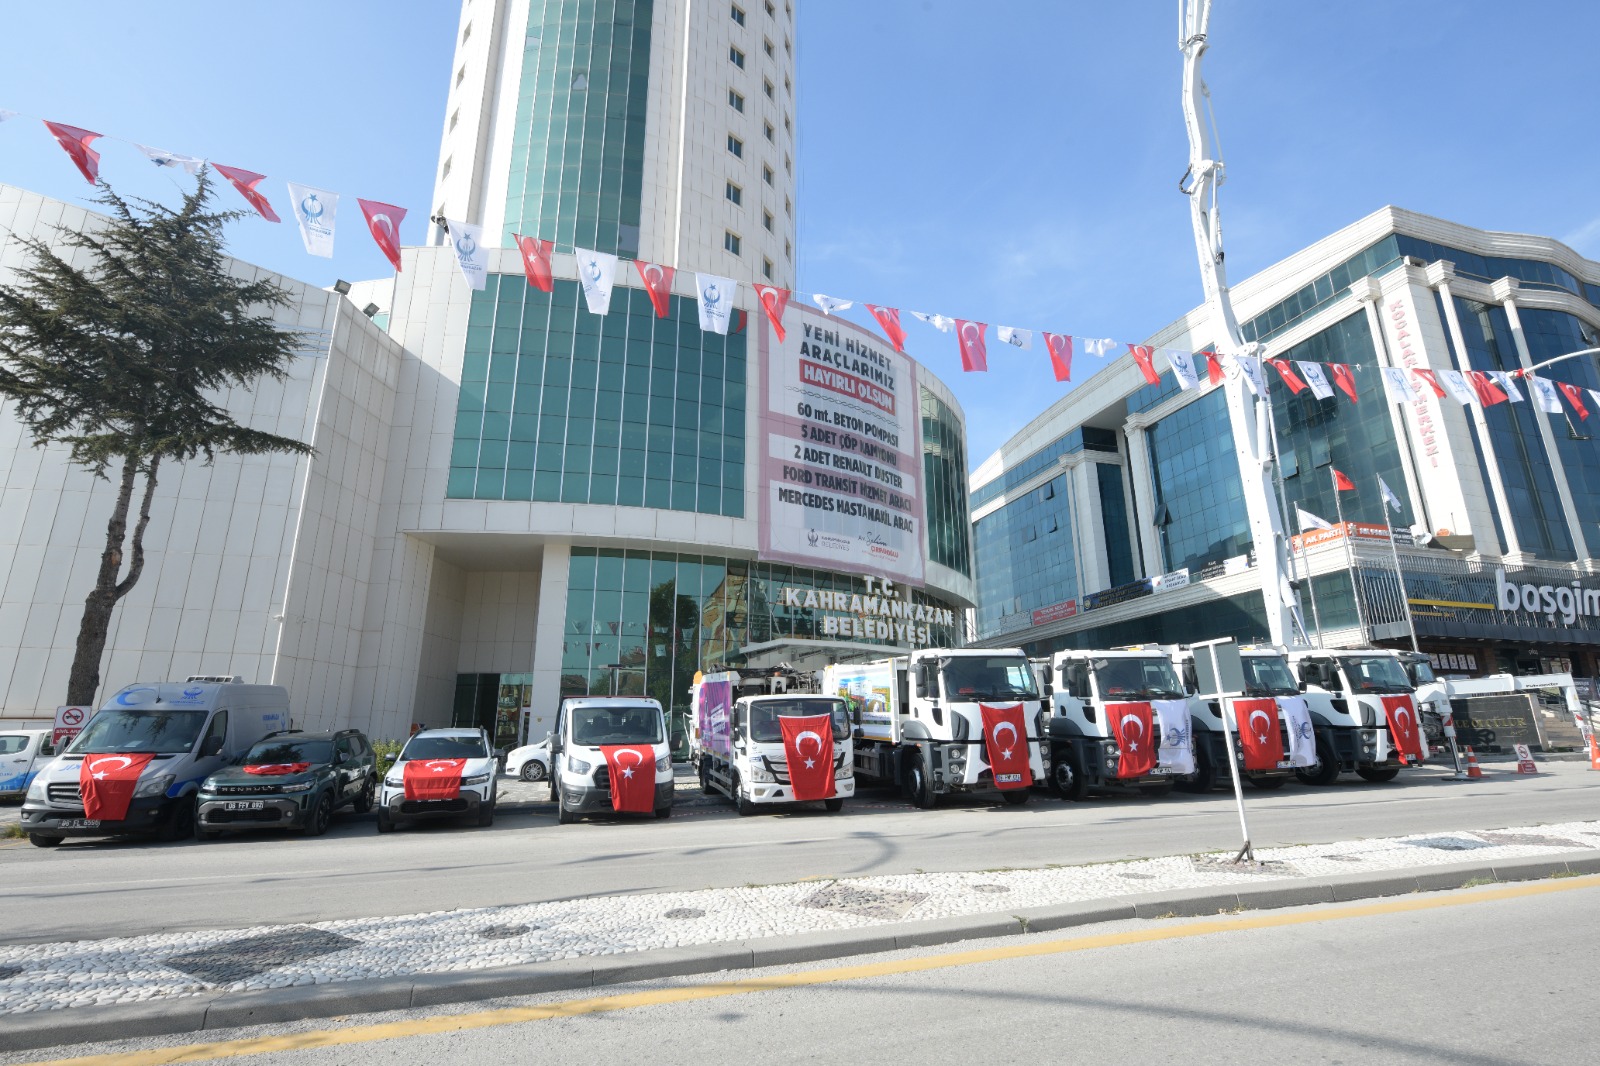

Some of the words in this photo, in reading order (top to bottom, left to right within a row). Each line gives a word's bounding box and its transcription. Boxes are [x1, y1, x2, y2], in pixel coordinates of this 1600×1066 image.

[800, 341, 895, 390] ARAÇLARIMIZ
[803, 322, 840, 347] YENİ
[845, 337, 892, 371] HİZMET
[804, 364, 856, 394] HAYIRLI
[857, 382, 893, 410] OLSUN
[797, 402, 812, 418] 60
[814, 408, 832, 423] mt.
[833, 411, 863, 433] BETON
[864, 422, 899, 448] POMPASI
[801, 424, 808, 438] 5
[810, 426, 837, 445] ADET
[839, 433, 858, 450] ÇÖP
[860, 442, 897, 466] KAMYONU
[783, 465, 812, 484] FORD
[815, 472, 858, 494] TRANSİT
[860, 481, 888, 502] HİZMET
[889, 493, 912, 512] ARACI
[794, 445, 802, 459] 2
[803, 447, 830, 466] ADET
[833, 454, 873, 477] RENAULT
[874, 466, 903, 489] DUSTER
[778, 487, 835, 512] MERCEDES
[1305, 535, 1317, 544] AK
[785, 587, 953, 627] KAHRAMANKAZAN
[863, 575, 900, 597] T.C.
[823, 615, 932, 645] BELEDİYESİ
